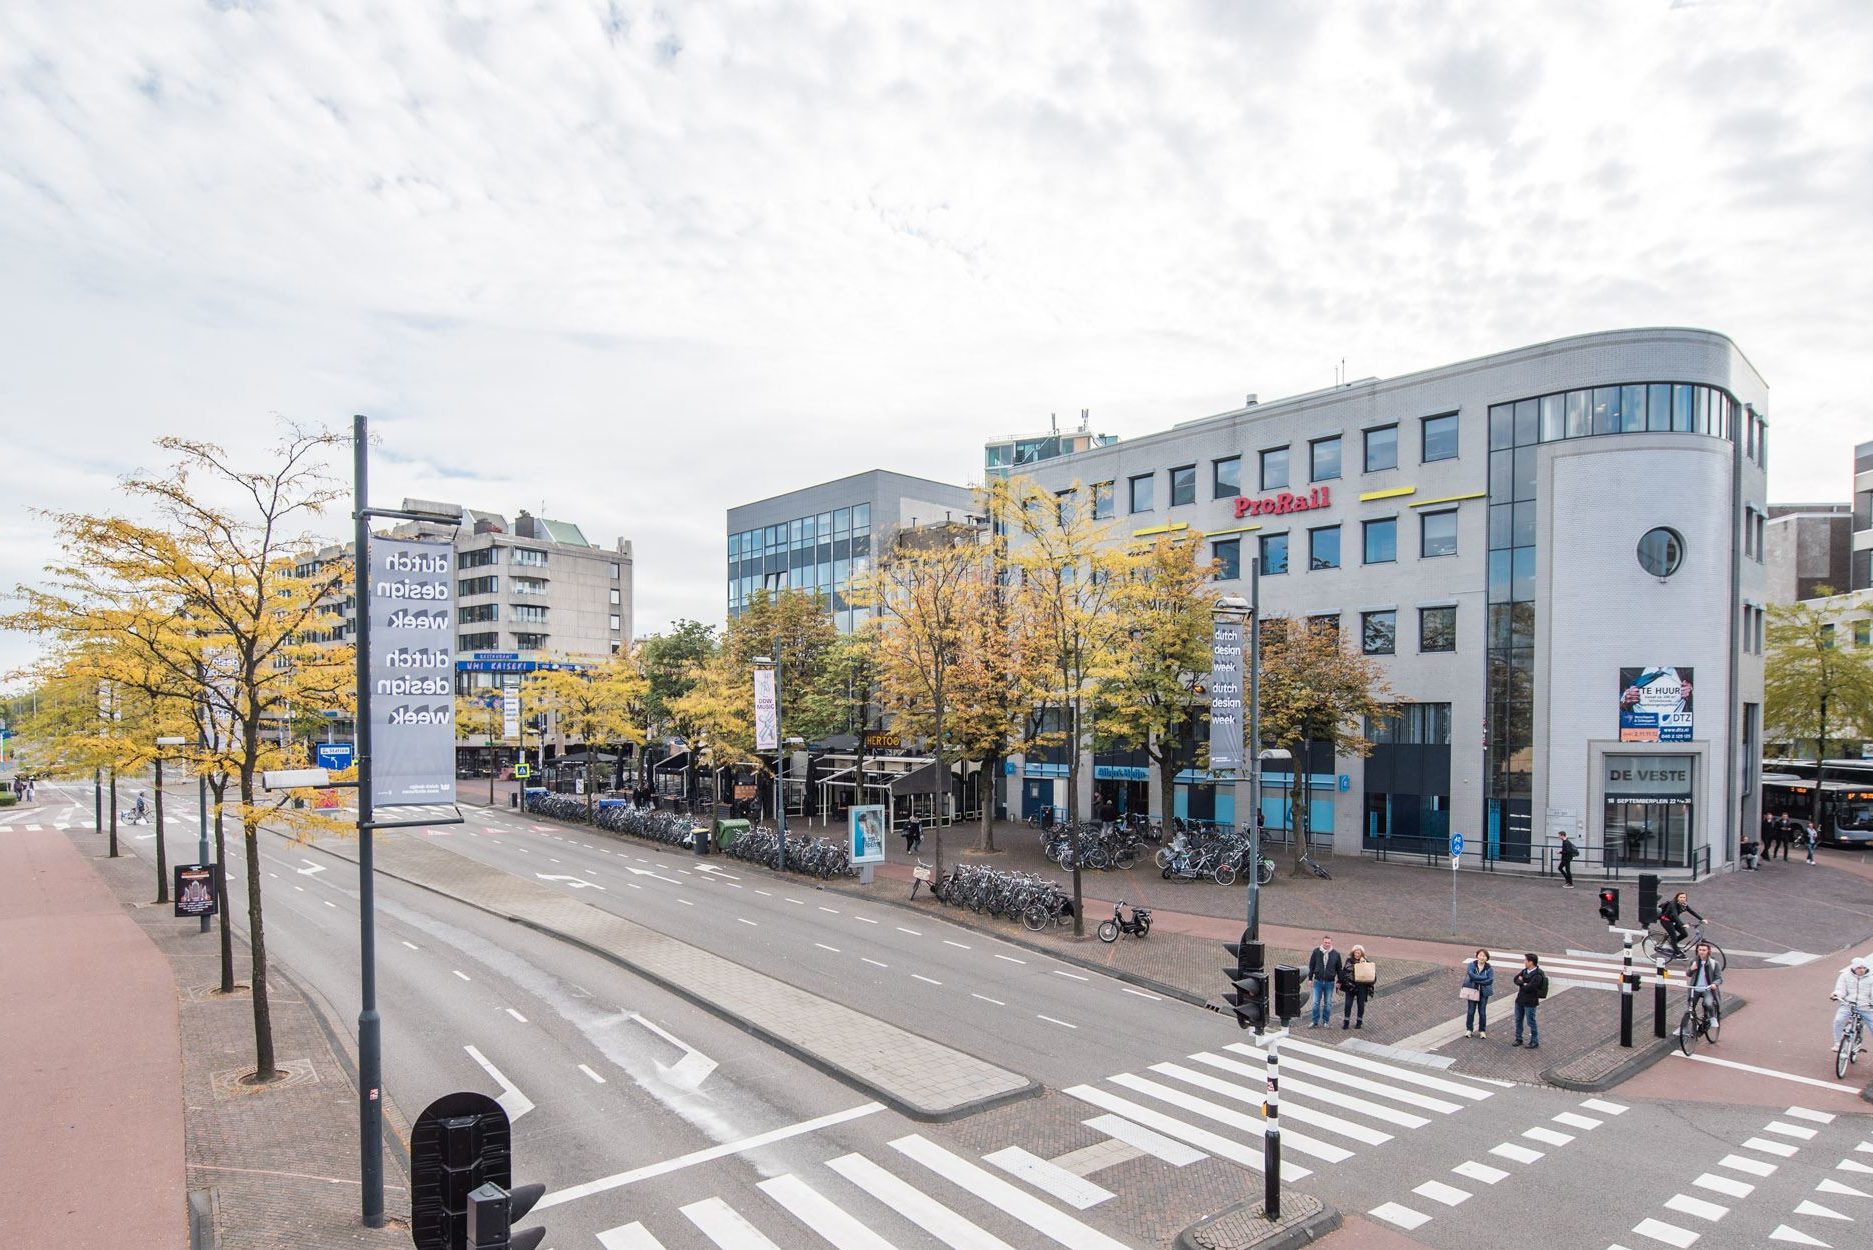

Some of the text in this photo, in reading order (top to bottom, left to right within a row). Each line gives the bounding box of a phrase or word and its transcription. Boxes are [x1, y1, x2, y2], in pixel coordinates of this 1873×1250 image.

[1234, 486, 1331, 518] ProRail
[1215, 630, 1238, 640] dutch
[1214, 644, 1241, 656] design
[467, 662, 527, 670] UMI KAISEKI
[1213, 662, 1236, 671] week
[1213, 683, 1237, 693] dutch
[1641, 687, 1681, 695] TE HUUR
[1213, 697, 1241, 709] design
[1212, 714, 1236, 725] week
[1673, 714, 1692, 722] DTZ
[1609, 769, 1687, 781] DE VESTE
